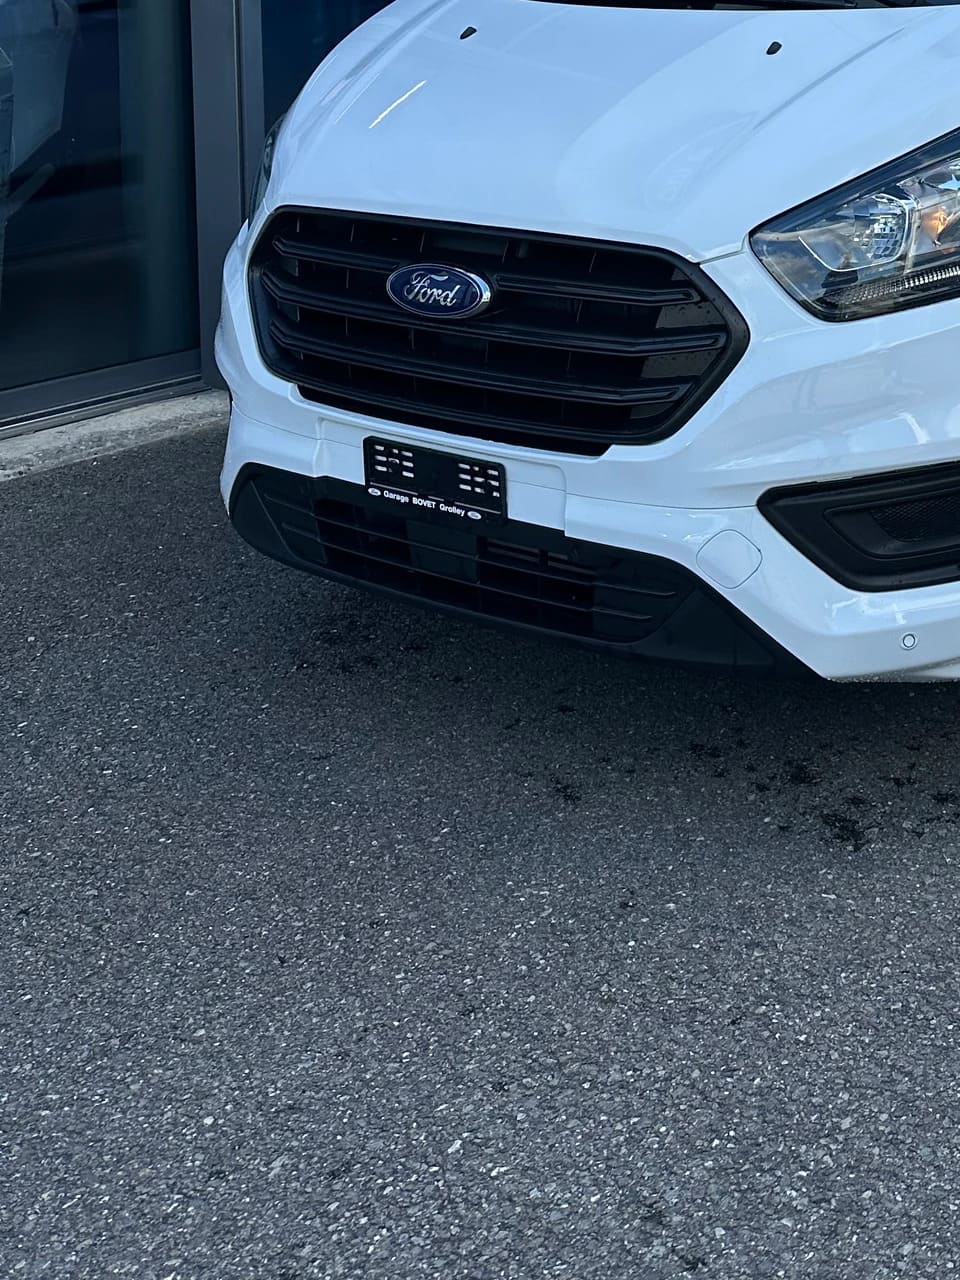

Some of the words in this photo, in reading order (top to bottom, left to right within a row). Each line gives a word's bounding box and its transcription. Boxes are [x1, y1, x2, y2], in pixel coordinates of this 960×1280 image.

[404, 271, 461, 307] Ford
[383, 490, 409, 503] Garage
[412, 497, 436, 509] BOVET
[439, 503, 465, 517] Grolley
